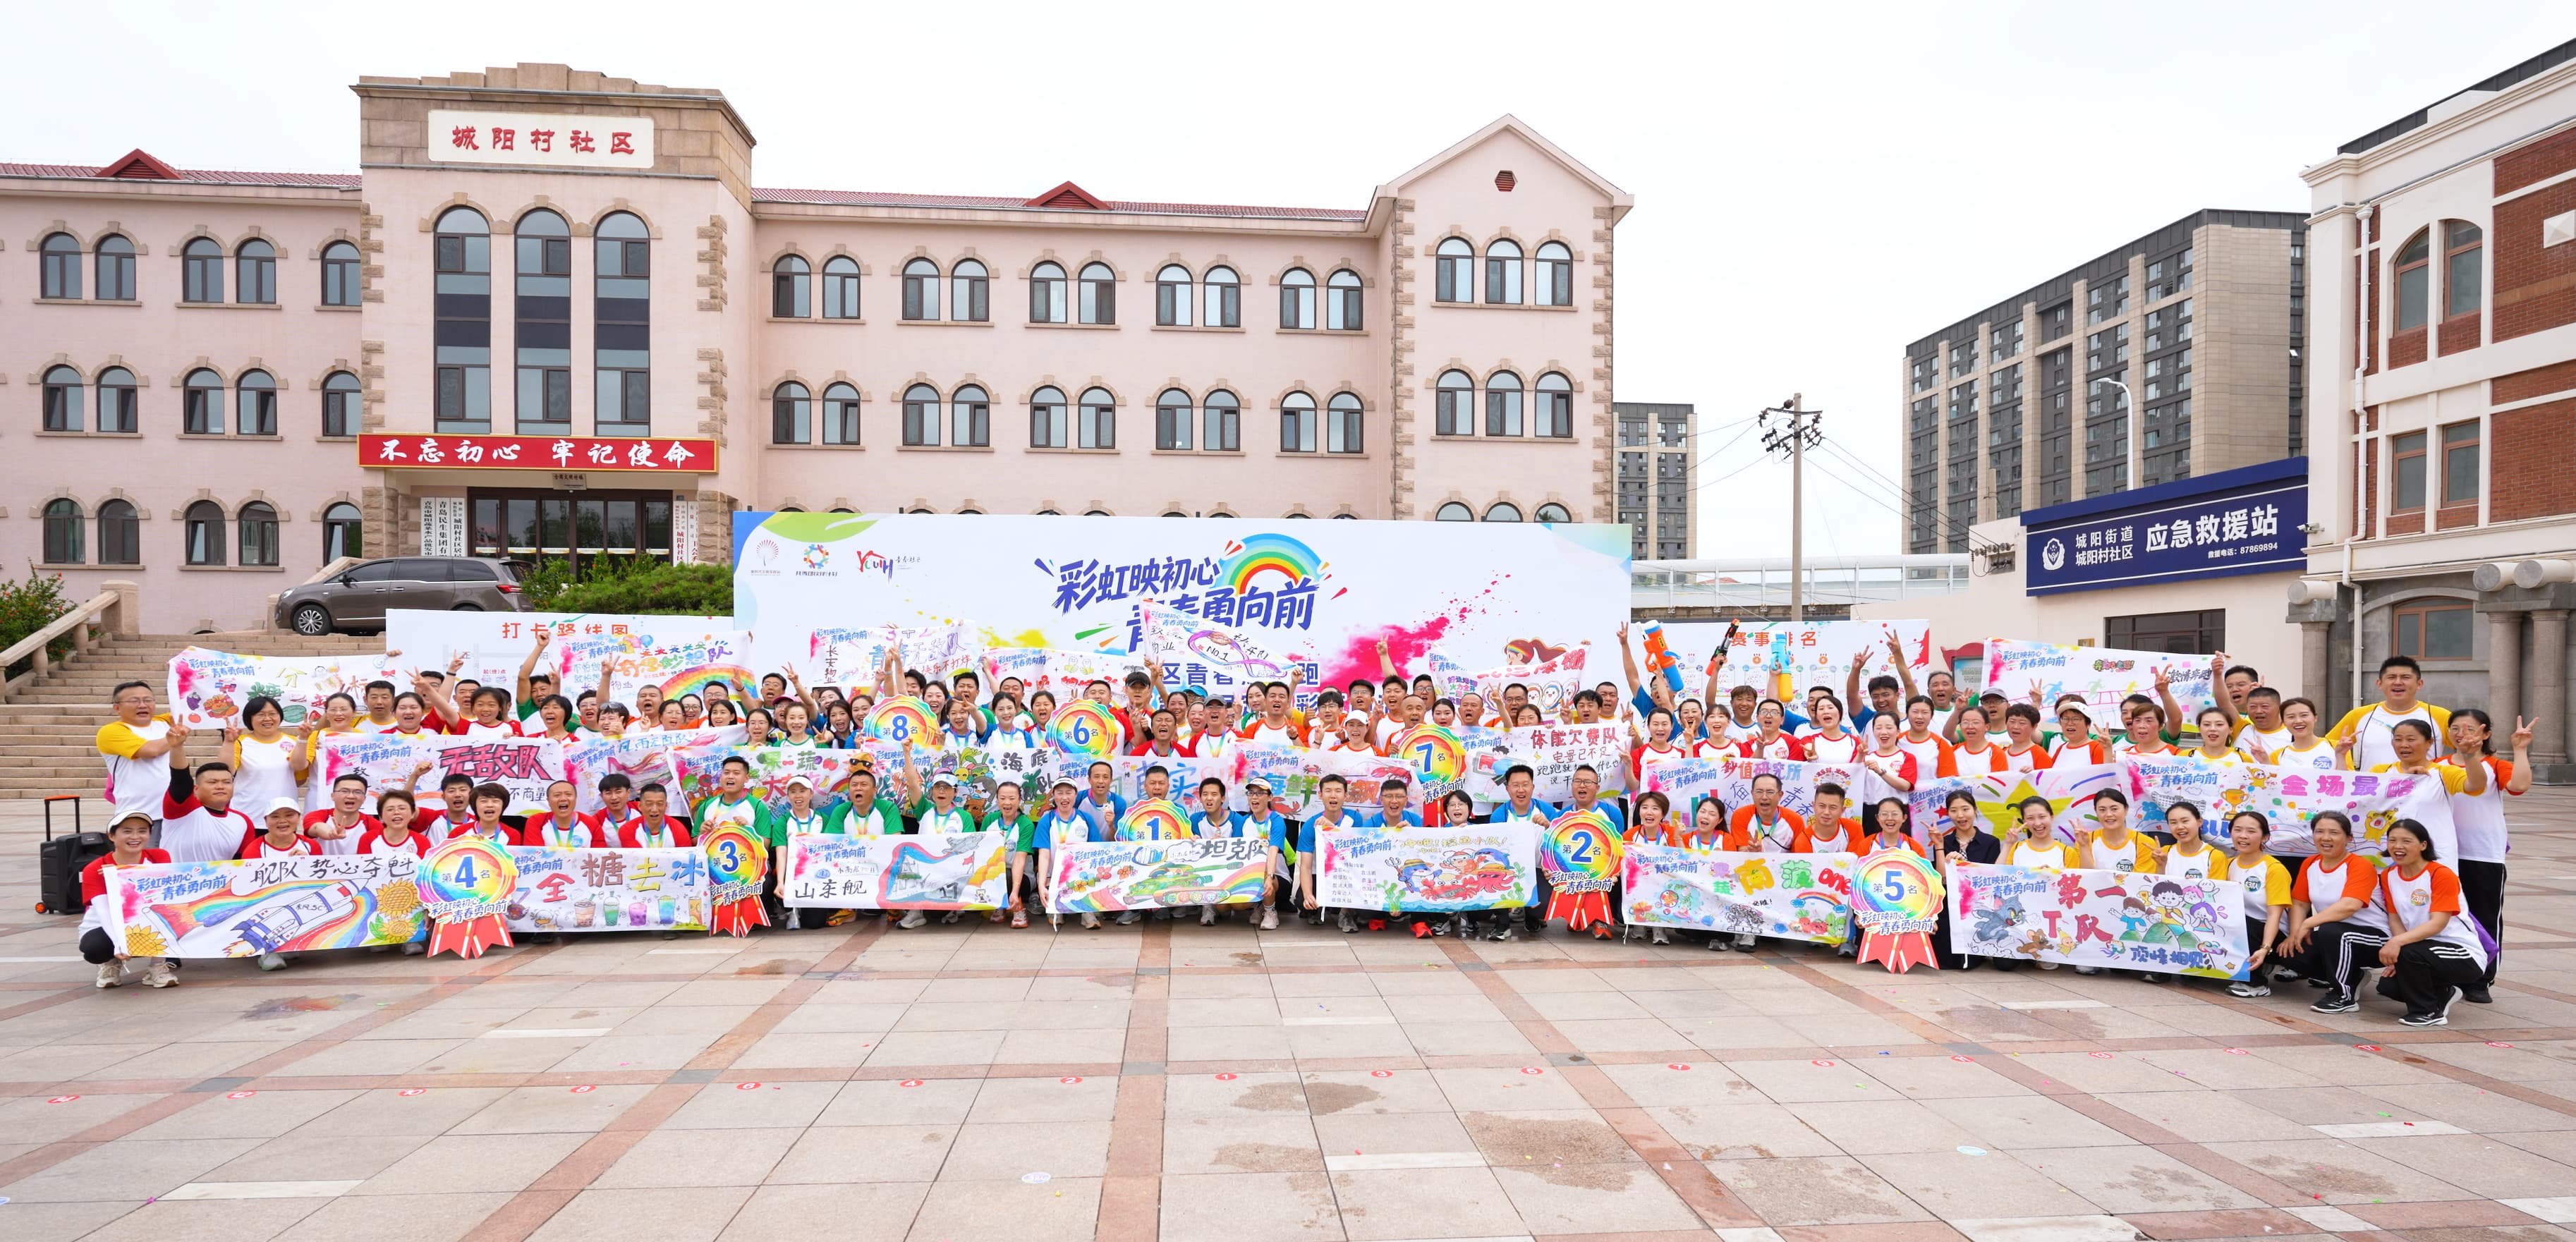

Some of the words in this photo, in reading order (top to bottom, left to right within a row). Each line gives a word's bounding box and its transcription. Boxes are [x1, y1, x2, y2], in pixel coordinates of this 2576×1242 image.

[452, 126, 634, 154] 城阳村社区
[379, 438, 521, 463] 不忘初心
[552, 439, 695, 468] 牢记使命
[2075, 525, 2134, 549] 城阳街道
[2146, 504, 2278, 552] 应急救援站
[2075, 543, 2134, 567] 城阳村社区
[1052, 556, 1221, 616] 彩虹映初心
[502, 623, 629, 638] 打卡路线图
[572, 640, 604, 652] 彩虹映初心
[589, 643, 627, 659] 青春勇向前
[2003, 650, 2042, 661] 彩虹映初心
[190, 658, 229, 669] 彩虹映初心
[212, 666, 255, 678] 青春勇向前
[2019, 655, 2067, 670] 青春勇向前
[883, 715, 918, 741] 第8名
[1064, 717, 1098, 745] 第6名
[1531, 727, 1620, 749] 体能欠费队
[340, 742, 384, 755] 彩虹映初心
[360, 745, 411, 764] 青春勇向前
[876, 750, 904, 760] 彩虹映初
[1245, 750, 1278, 760] 彩虹映初心
[1411, 741, 1445, 773] 第7名
[437, 743, 556, 783] 无敌队
[686, 753, 723, 767] 彩虹映初心
[891, 755, 931, 768] 青春向前
[1001, 749, 1048, 772] 海底
[1260, 757, 1299, 769] 青春勇向前
[2140, 764, 2187, 775] 彩虹映初心
[1658, 767, 1694, 781] 彩虹映初心
[1675, 769, 1718, 789] 青春勇向前
[2161, 772, 2218, 787] 青春勇向前
[1425, 779, 1464, 803] 青春勇向前
[2281, 774, 2417, 798] 全场最酷
[1928, 786, 1972, 809] 青春前
[1136, 817, 1172, 841] 第1名
[808, 843, 844, 854] 彩虹映初心
[1200, 839, 1268, 860] 坦克队
[1334, 835, 1370, 851] 彩虹映初心
[1350, 839, 1392, 858] 青春勇向前
[1563, 832, 1601, 864] 第2名
[713, 841, 747, 872] 第3名
[825, 847, 865, 862] 青春勇向前
[1074, 849, 1111, 863] 彩虹映初心
[1090, 851, 1132, 869] 青春勇向前
[1636, 853, 1674, 865] 彩虹映初心
[442, 856, 490, 889] 第4名
[536, 851, 706, 903] 全糖去冰
[1655, 860, 1698, 875] 青春勇向前
[136, 872, 193, 891] 彩虹映初心
[1551, 871, 1590, 885] 彩虹映初心
[1567, 877, 1612, 894] 青春勇向前
[1873, 870, 1917, 903] 第5名
[1972, 875, 2017, 888] 彩虹映初心
[162, 875, 227, 901] 青春勇向前
[723, 882, 763, 906] 青春勇向前
[795, 879, 868, 900] 山东舰
[1992, 881, 2047, 899] 青春勇向前
[2057, 872, 2127, 910] 第一
[431, 898, 479, 916] 彩虹映初心
[452, 900, 507, 923] 青春勇向前
[1860, 911, 1907, 925] 彩虹映初心
[1880, 914, 1933, 934] 青春勇向前
[2130, 945, 2206, 969] 顶峰相见
